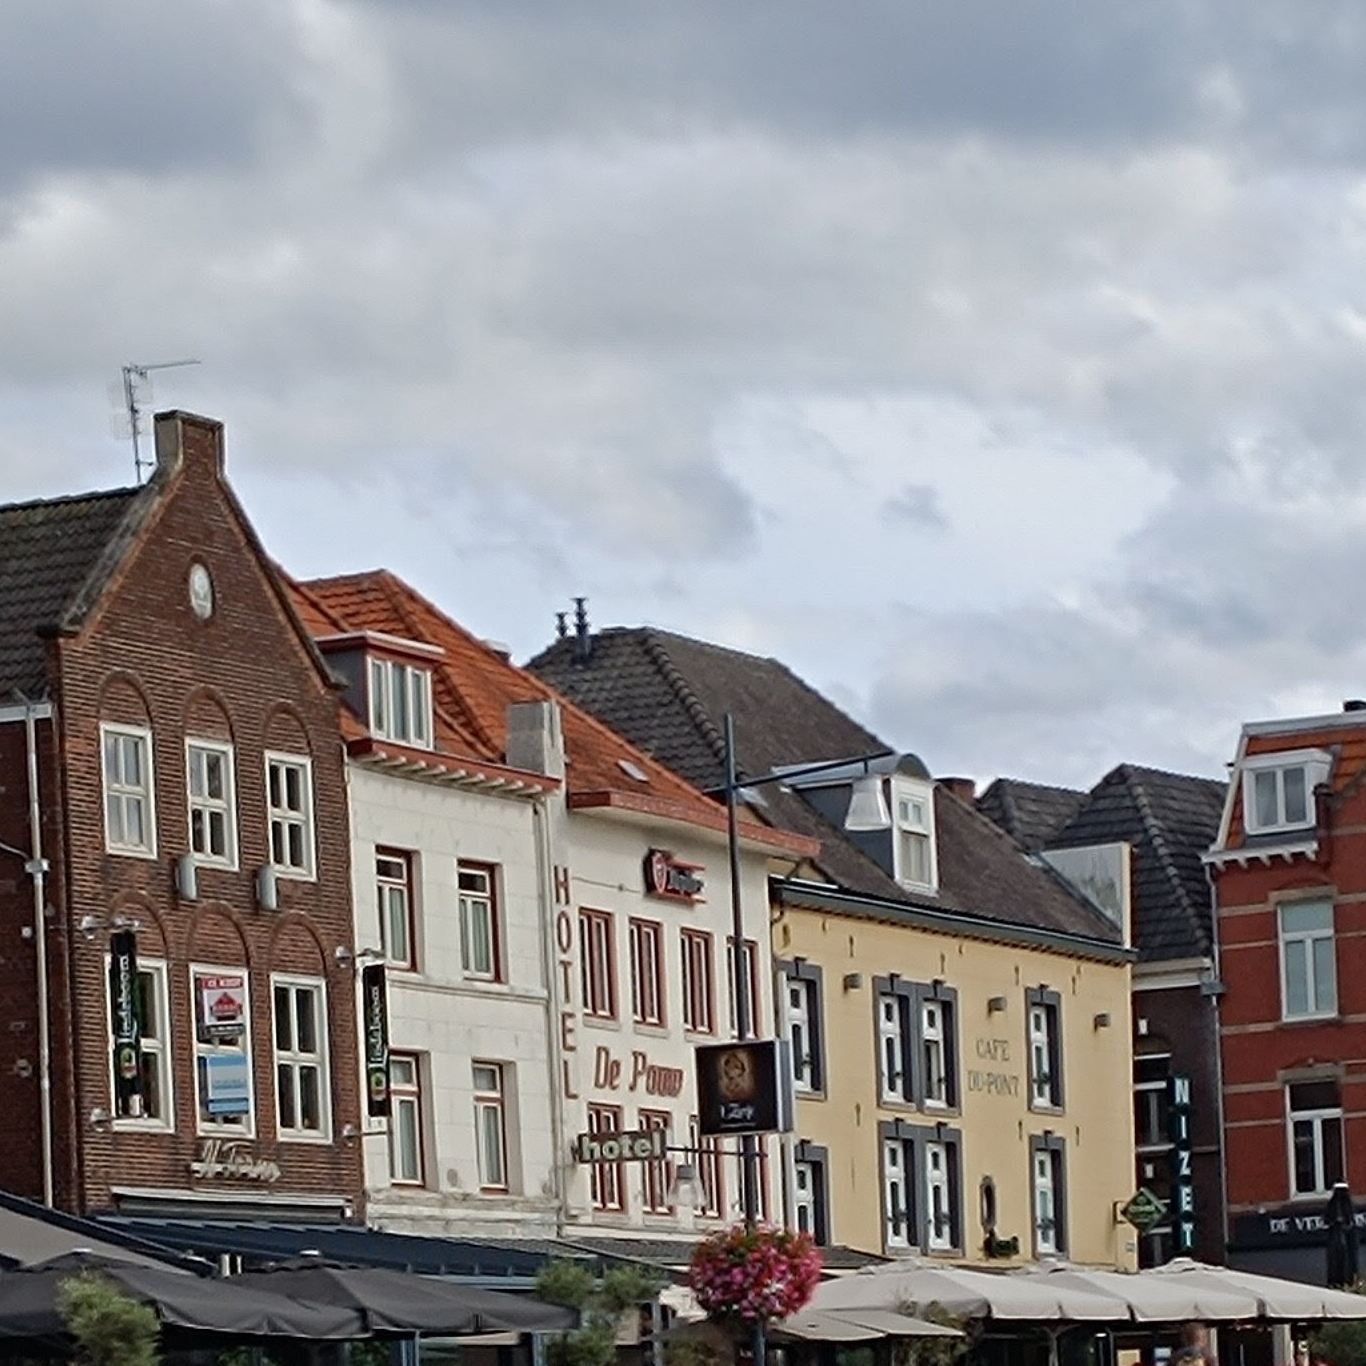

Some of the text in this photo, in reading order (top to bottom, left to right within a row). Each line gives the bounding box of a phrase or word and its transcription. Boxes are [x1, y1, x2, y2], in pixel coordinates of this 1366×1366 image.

[554, 865, 578, 1100] HOTEL
[594, 1046, 621, 1090] De
[582, 1134, 662, 1162] hotel
[1174, 1078, 1194, 1248] NIZET
